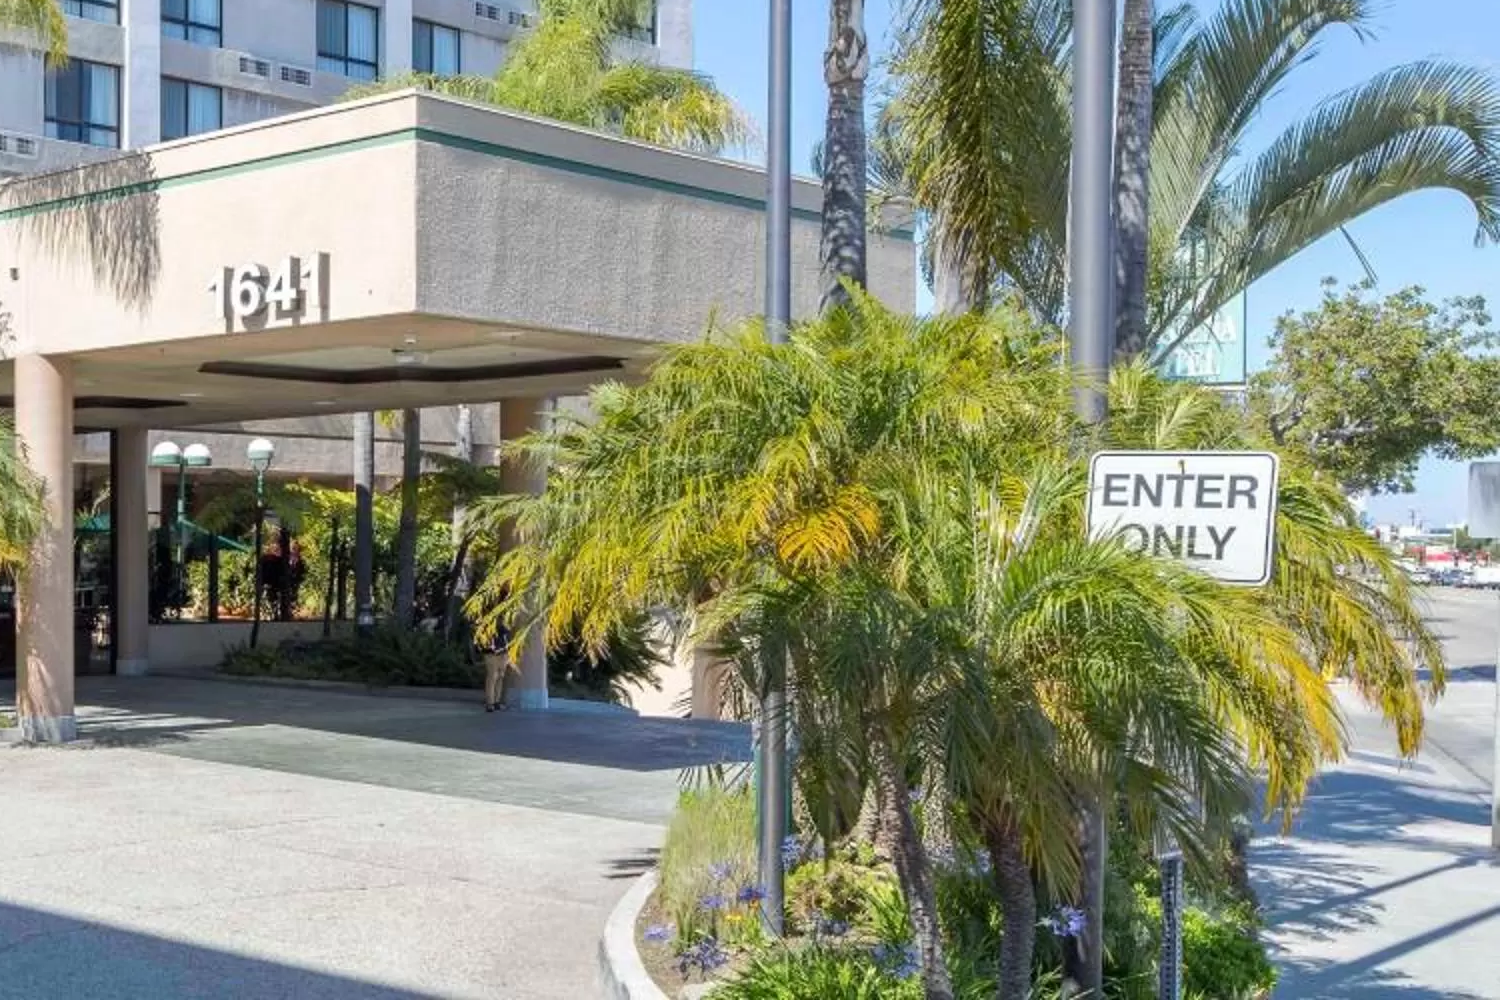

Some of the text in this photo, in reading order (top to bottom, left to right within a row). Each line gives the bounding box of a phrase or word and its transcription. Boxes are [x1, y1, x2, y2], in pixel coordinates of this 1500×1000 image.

[205, 249, 322, 322] 1641
[1101, 473, 1259, 509] ENTER
[1119, 522, 1236, 561] ONLY
